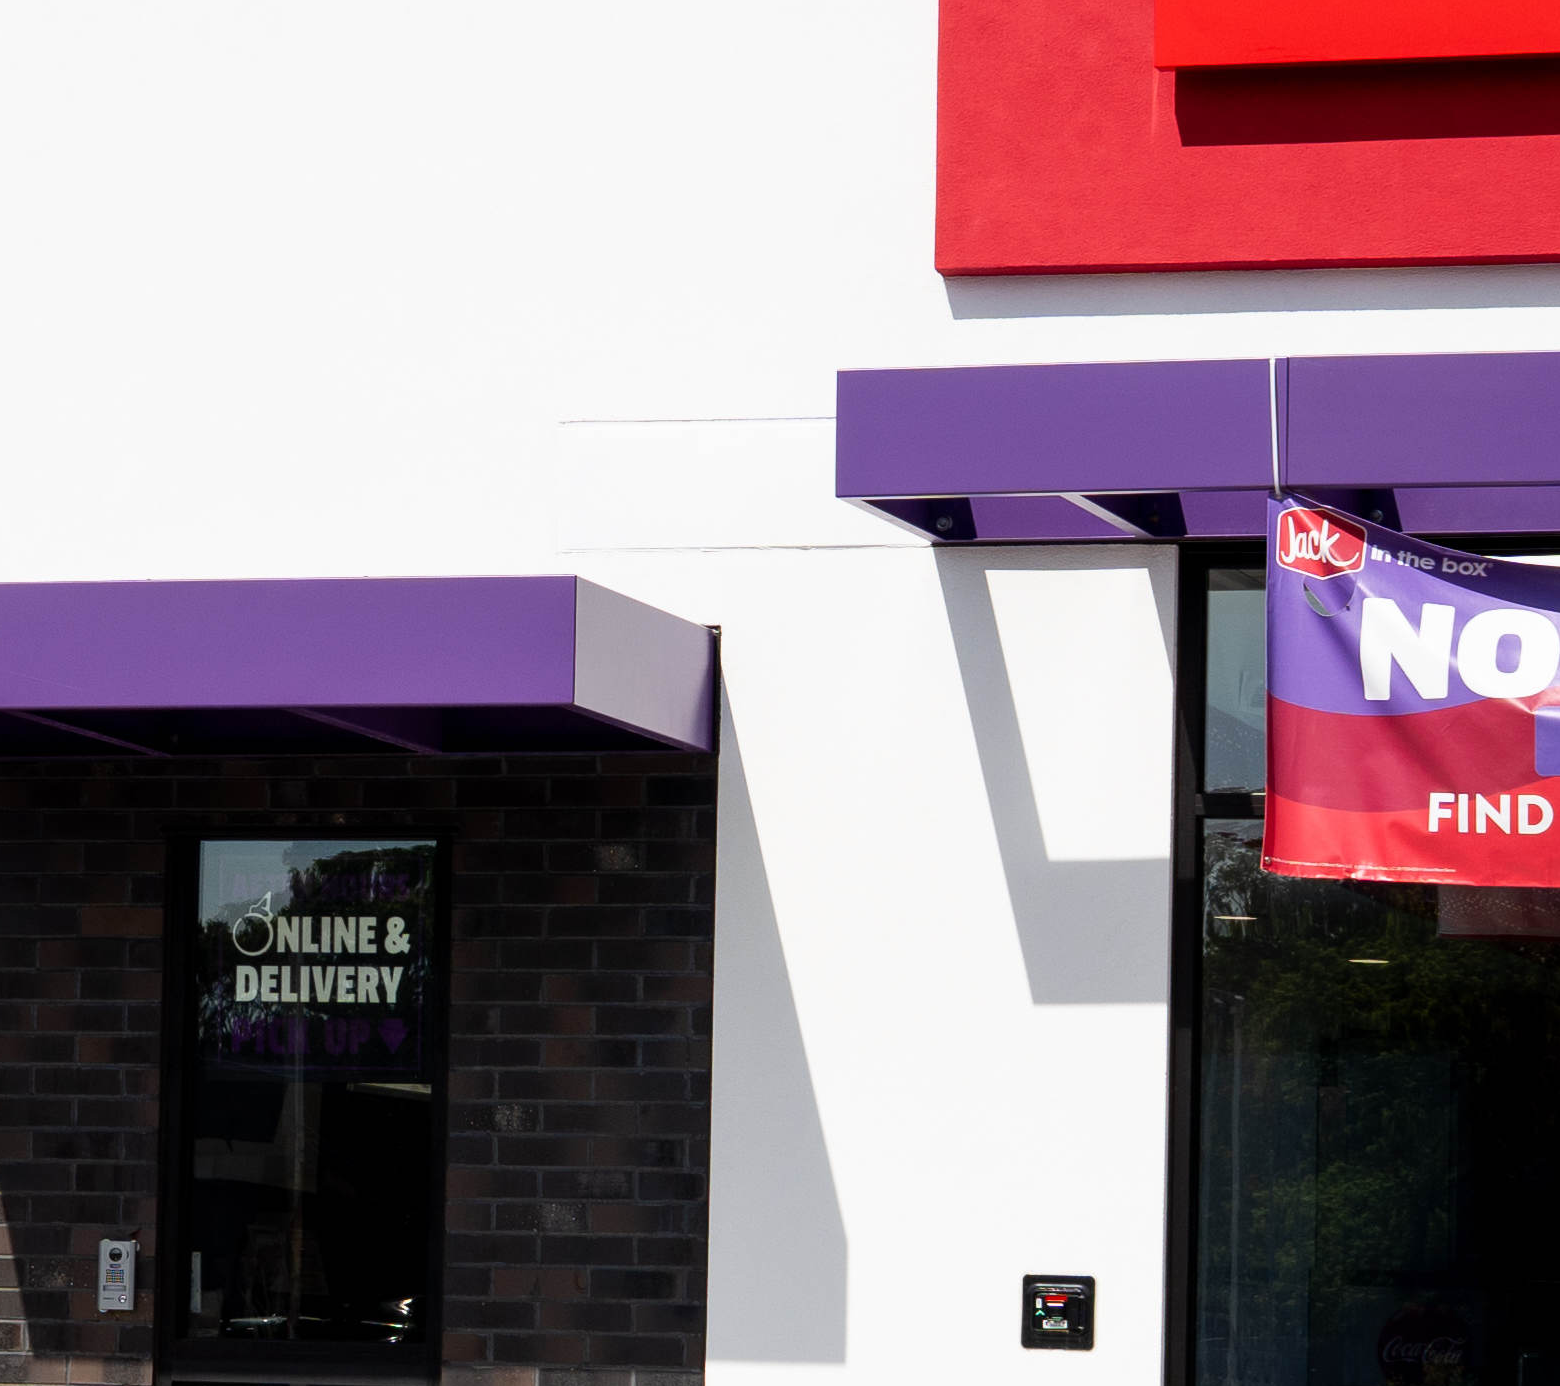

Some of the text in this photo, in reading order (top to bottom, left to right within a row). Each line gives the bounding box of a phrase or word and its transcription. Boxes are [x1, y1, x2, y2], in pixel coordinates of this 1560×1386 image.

[1280, 516, 1360, 567] Jack
[1371, 545, 1392, 563] in
[1397, 550, 1435, 570] the
[1427, 791, 1555, 835] FIND
[384, 916, 411, 954] &
[235, 966, 404, 1004] DELIVERY
